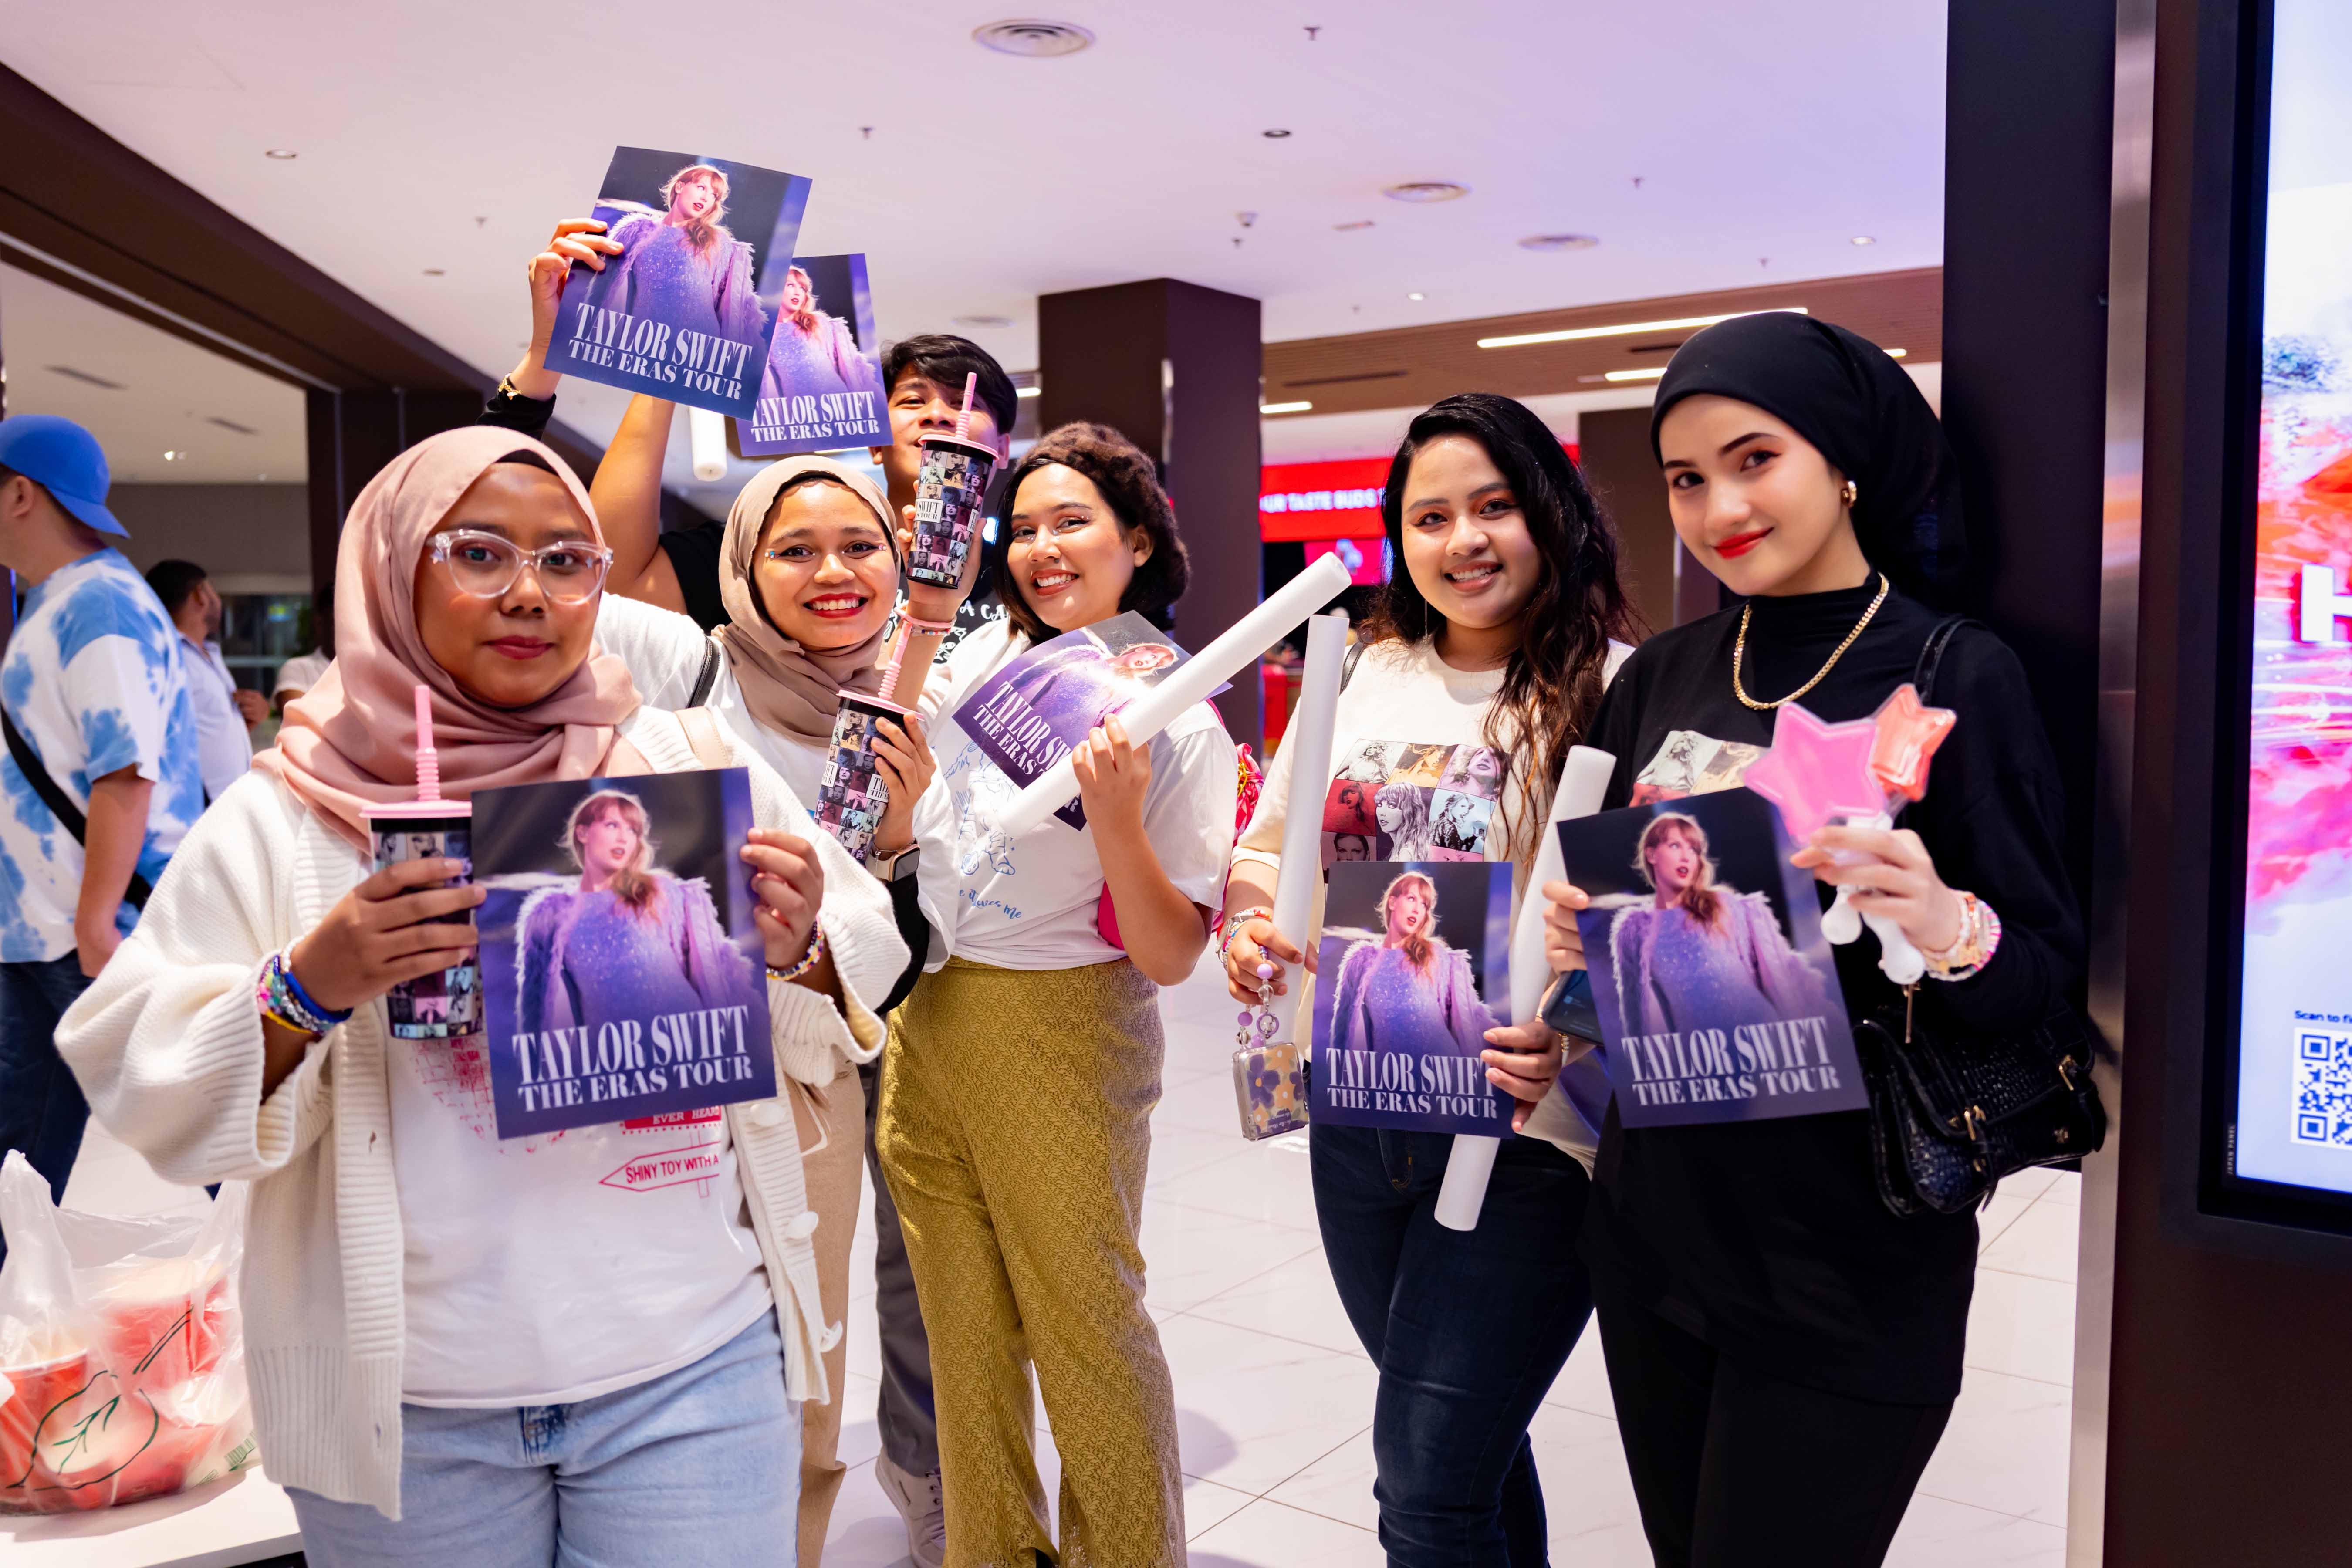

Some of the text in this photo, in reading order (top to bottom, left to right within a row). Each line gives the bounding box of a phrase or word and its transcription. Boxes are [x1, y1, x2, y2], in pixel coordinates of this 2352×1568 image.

[574, 302, 753, 380] TAYLOR SWIFT
[568, 340, 742, 400] THE ERAS TOUR
[820, 391, 876, 422] SWIFT
[751, 419, 880, 442] THE ERAS TOUR
[1288, 490, 1333, 511] TASTE
[1333, 488, 1377, 509] BUDS
[980, 604, 1007, 621] CA
[984, 681, 1051, 754] TAYLOR
[973, 704, 1037, 774] THE ERAS
[2294, 1010, 2325, 1020] Scan
[2327, 1014, 2340, 1023] to
[512, 1004, 749, 1085] TAYLOR SWIFT
[1621, 1016, 1831, 1082] TAYLOR SWIFT
[517, 1055, 753, 1112] THE ERAS TOUR
[1326, 1048, 1494, 1097] TAYLOR SWIFT
[1632, 1065, 1841, 1106] THE ERAS TOUR
[653, 1111, 685, 1125] EVER
[1327, 1088, 1497, 1118] THE ERAS TOUR
[625, 1154, 719, 1184] SHINY TOY WITH A
